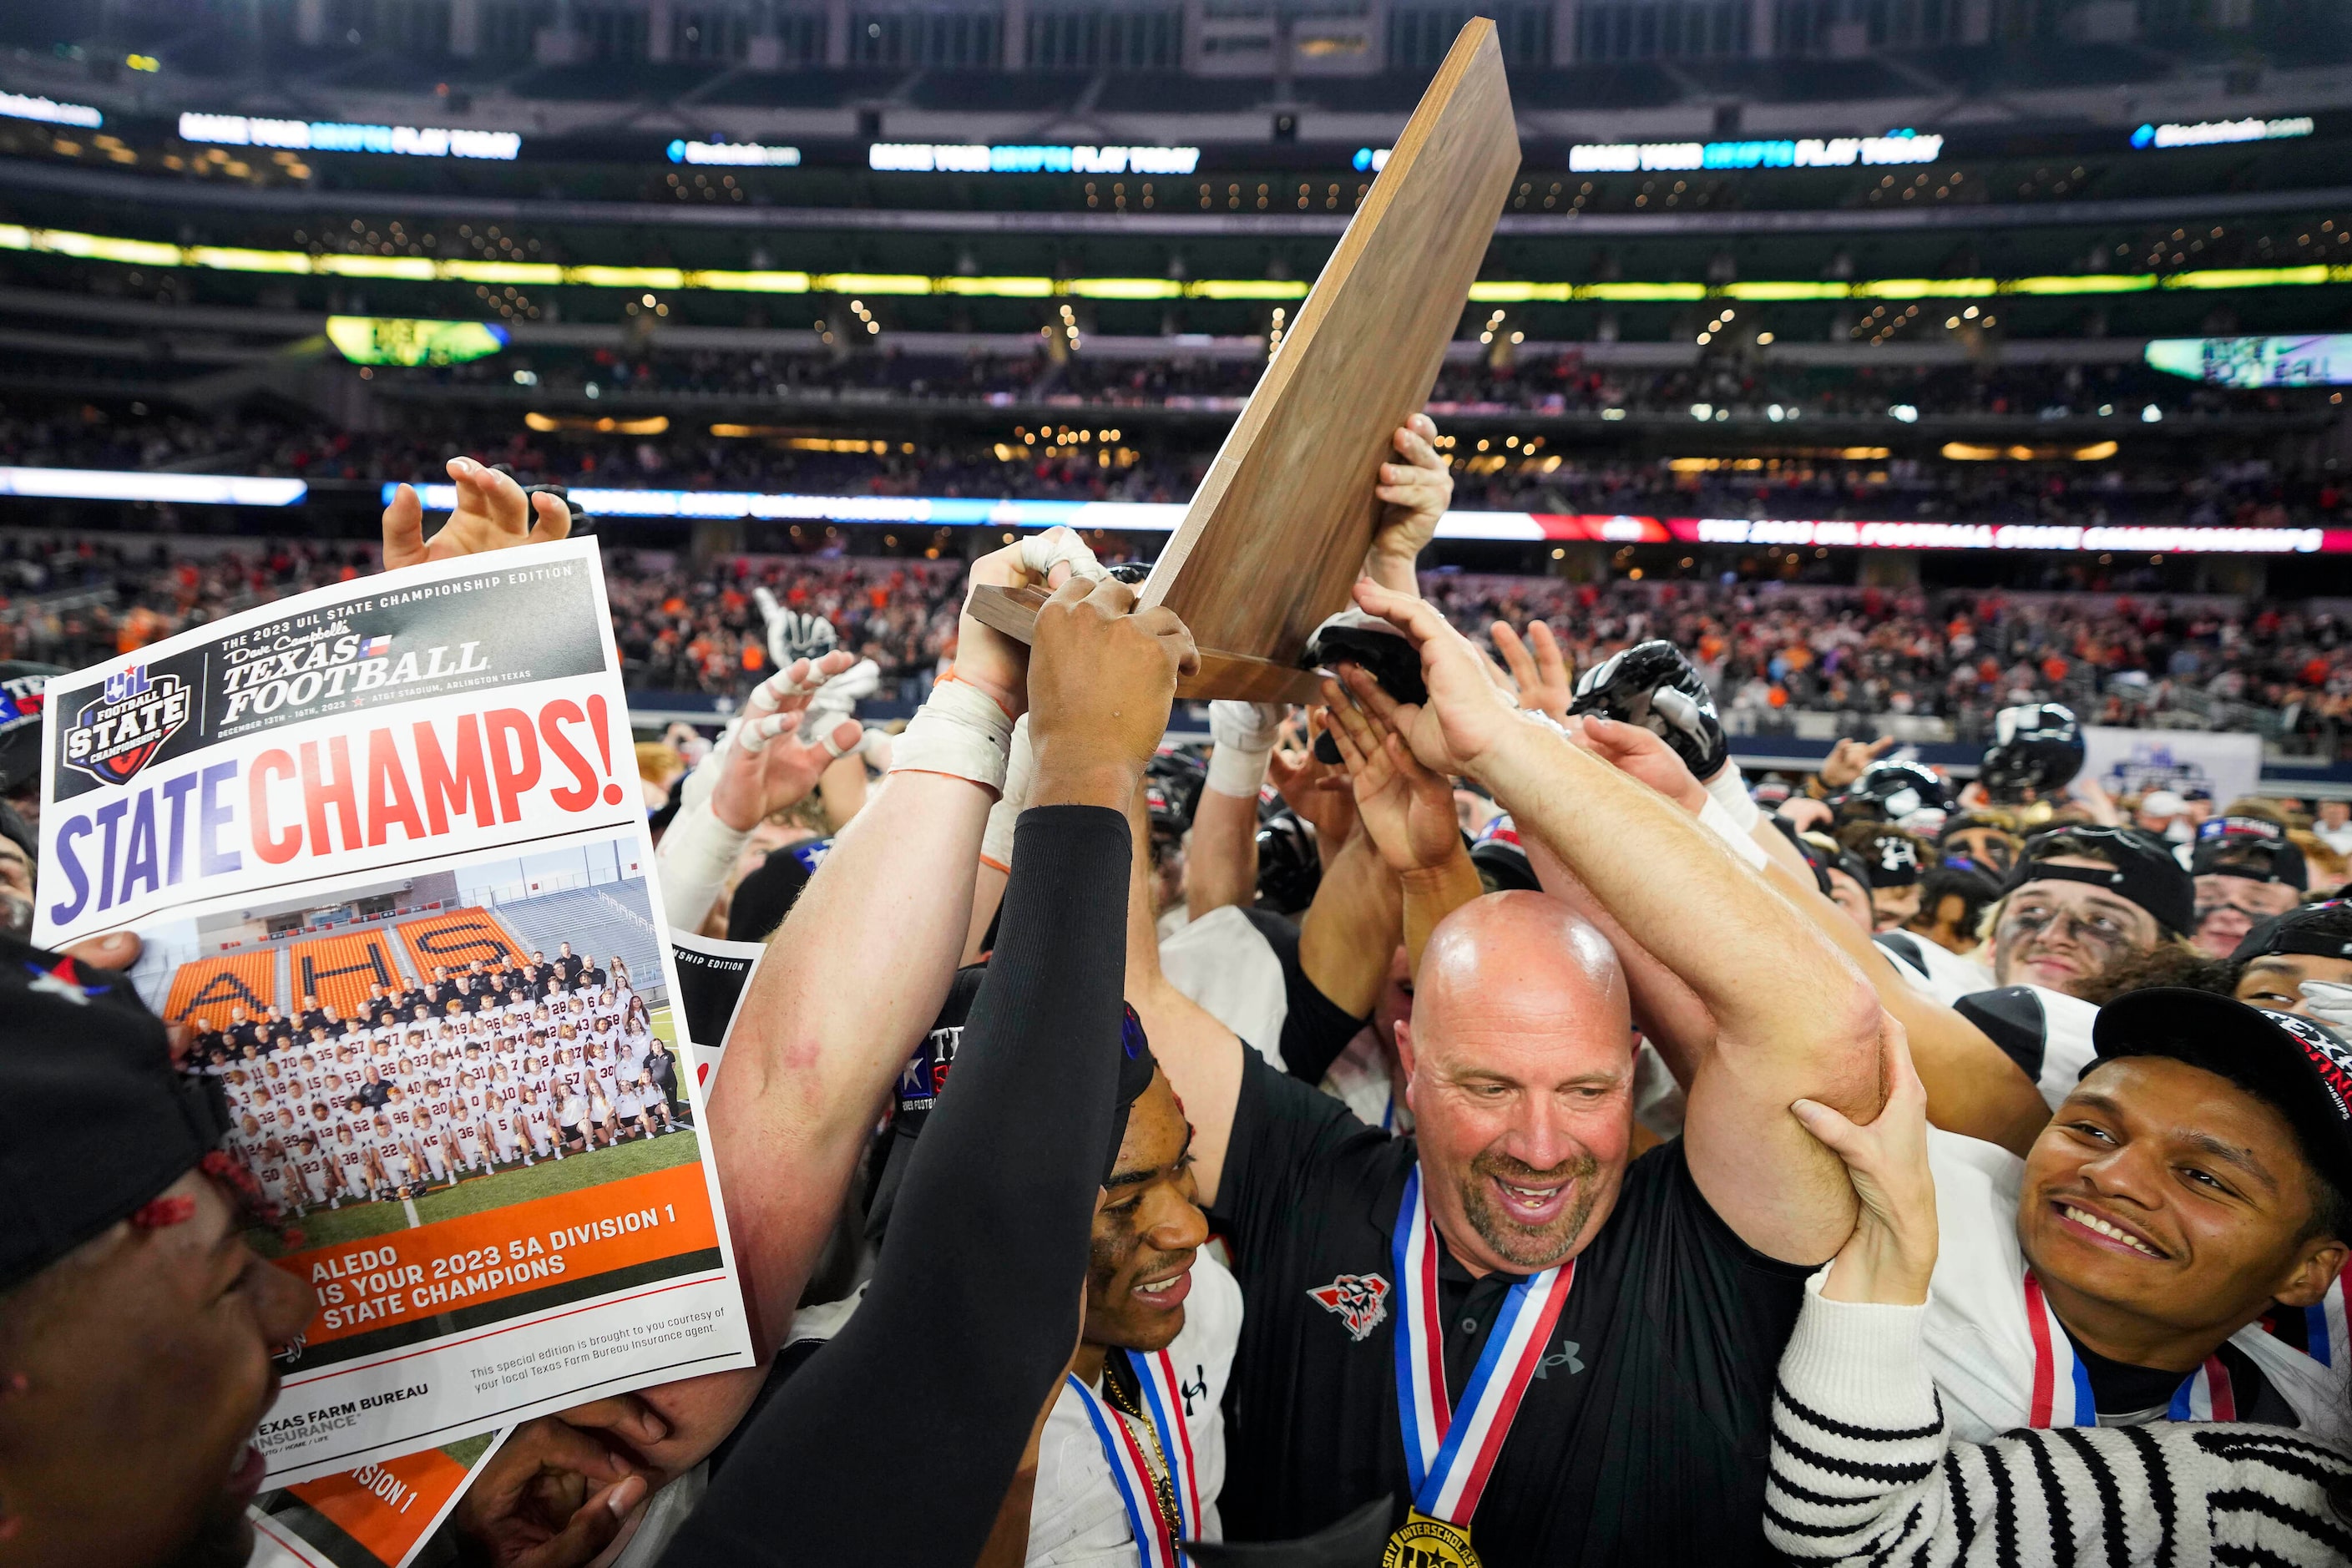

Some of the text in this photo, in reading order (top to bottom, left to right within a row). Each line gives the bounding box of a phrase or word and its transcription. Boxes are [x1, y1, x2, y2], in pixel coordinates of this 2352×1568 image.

[222, 566, 573, 651] THE 2023 UIL STATE CHAMPIONSHIP EDITION
[224, 620, 351, 665] Dave Campbell's
[222, 634, 361, 695] TEXAS
[220, 641, 488, 726] FOOTBALL
[398, 685, 443, 698] STADIUM,
[447, 675, 499, 690] ARLINGTON
[501, 670, 531, 681] TEXAS
[97, 690, 159, 721] FOOTBALL
[68, 691, 185, 759] STATE
[217, 720, 262, 738] DECEMBER
[265, 715, 286, 725] 13TH
[321, 701, 346, 711] 2023
[90, 729, 162, 763] CHAMPIONSHIPS
[50, 693, 623, 926] STATE CHAMPS!
[707, 959, 744, 971] EDITION
[552, 1002, 566, 1014] 28
[588, 997, 594, 1008] 6
[454, 1024, 467, 1034] 19
[575, 1019, 589, 1032] 43
[2258, 1009, 2352, 1080] TEXA
[316, 1049, 332, 1061] 35
[447, 1045, 462, 1060] 44
[281, 1057, 297, 1070] 70
[412, 1054, 428, 1067] 33
[250, 1068, 264, 1080] 11
[381, 1062, 396, 1075] 26
[472, 1067, 486, 1080] 31
[600, 1066, 613, 1078] 30
[345, 1070, 361, 1083] 63
[564, 1072, 579, 1085] 57
[307, 1077, 321, 1090] 15
[407, 1082, 421, 1095] 40
[534, 1080, 547, 1094] 41
[240, 1092, 250, 1104] 3
[503, 1087, 516, 1100] 10
[471, 1096, 479, 1106] 0
[432, 1102, 448, 1115] 20
[392, 1111, 409, 1124] 96
[531, 1110, 544, 1124] 14
[498, 1119, 507, 1130] 5
[459, 1127, 474, 1139] 36
[423, 1135, 438, 1147] 45
[381, 1144, 398, 1158] 22
[317, 1204, 675, 1307] IS YOUR 2023 5A DIVISION 1
[311, 1246, 397, 1284] ALEDO
[323, 1254, 566, 1329] STATE CHAMPIONS
[470, 1307, 725, 1378] This special edition is brought to you courtesy of
[474, 1324, 716, 1394] your local Texas Farm Bureau Insurance agent.
[259, 1383, 429, 1436] EXAS FARM BUREAU
[262, 1448, 277, 1457] UTO
[352, 1463, 417, 1514] ISION 1
